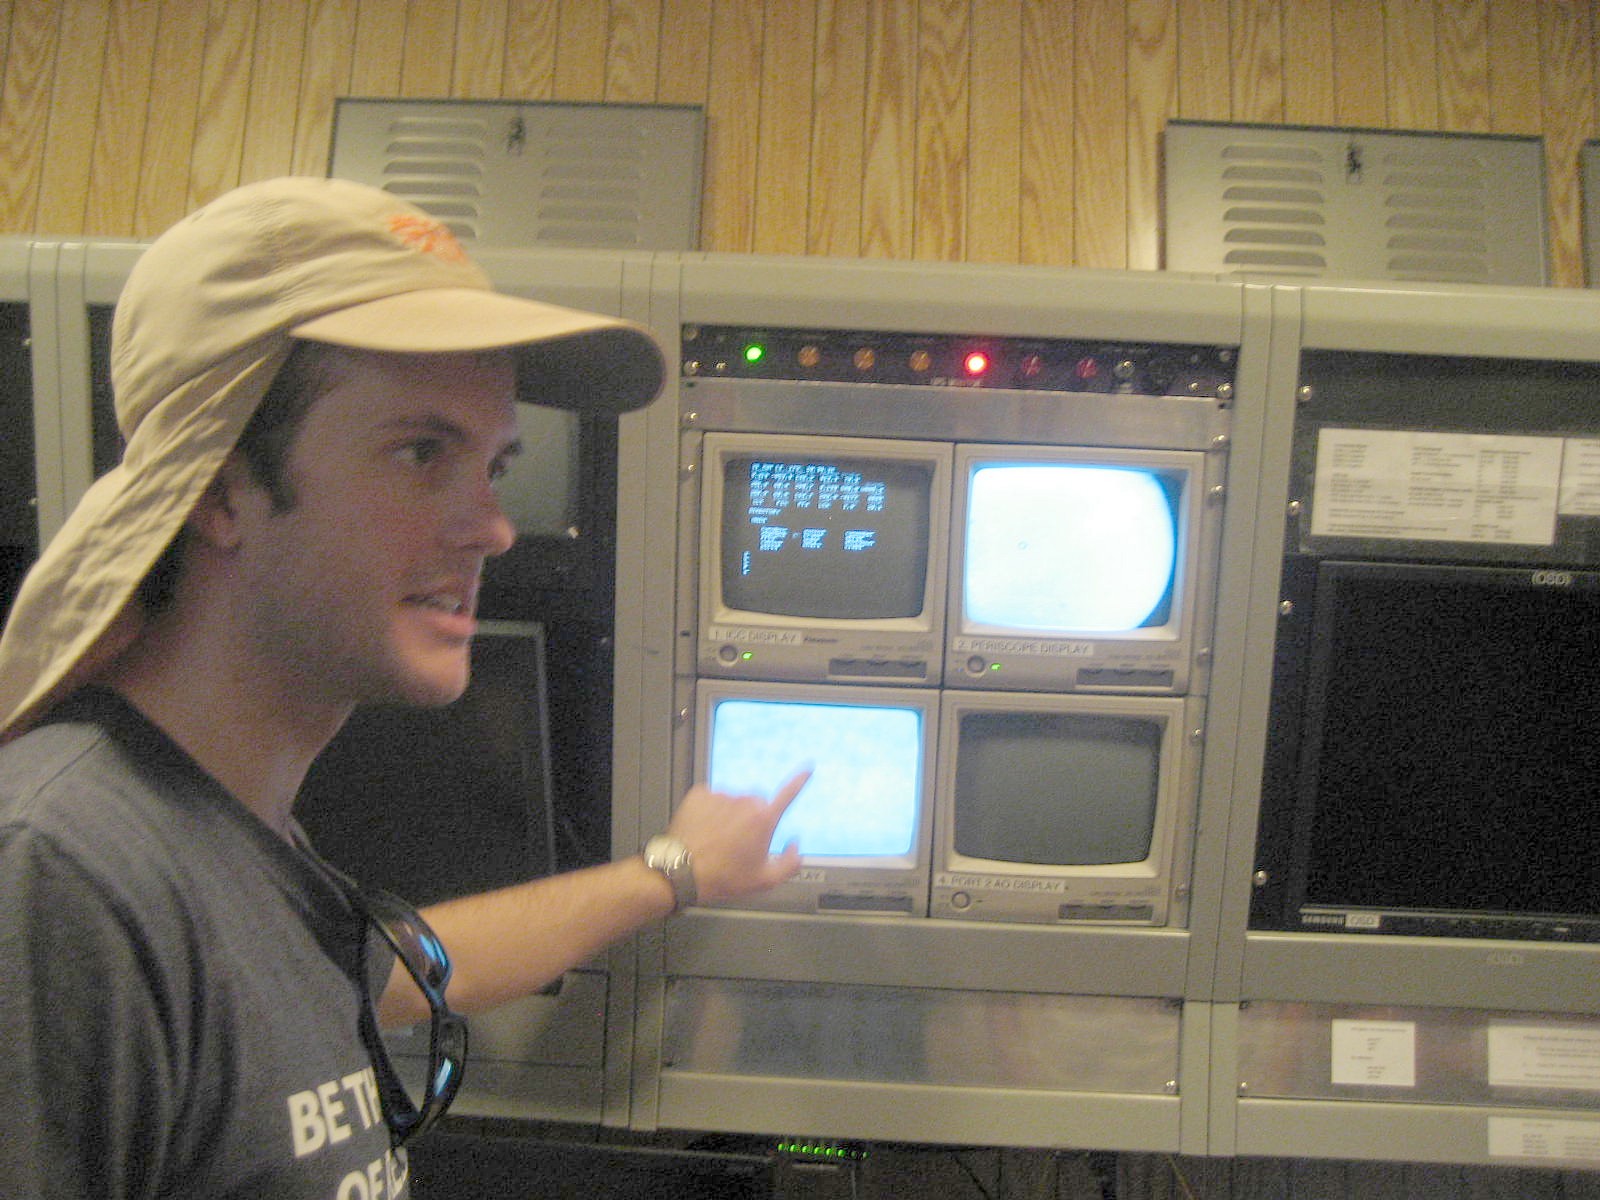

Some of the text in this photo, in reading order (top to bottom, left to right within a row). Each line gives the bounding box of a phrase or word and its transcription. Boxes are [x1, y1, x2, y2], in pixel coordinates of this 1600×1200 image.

[748, 631, 798, 642] DISPLAY
[970, 640, 1036, 653] PERISCOPE
[1039, 642, 1090, 655] DISPLAY
[1013, 879, 1063, 891] DISPLAY
[287, 1079, 352, 1158] BE
